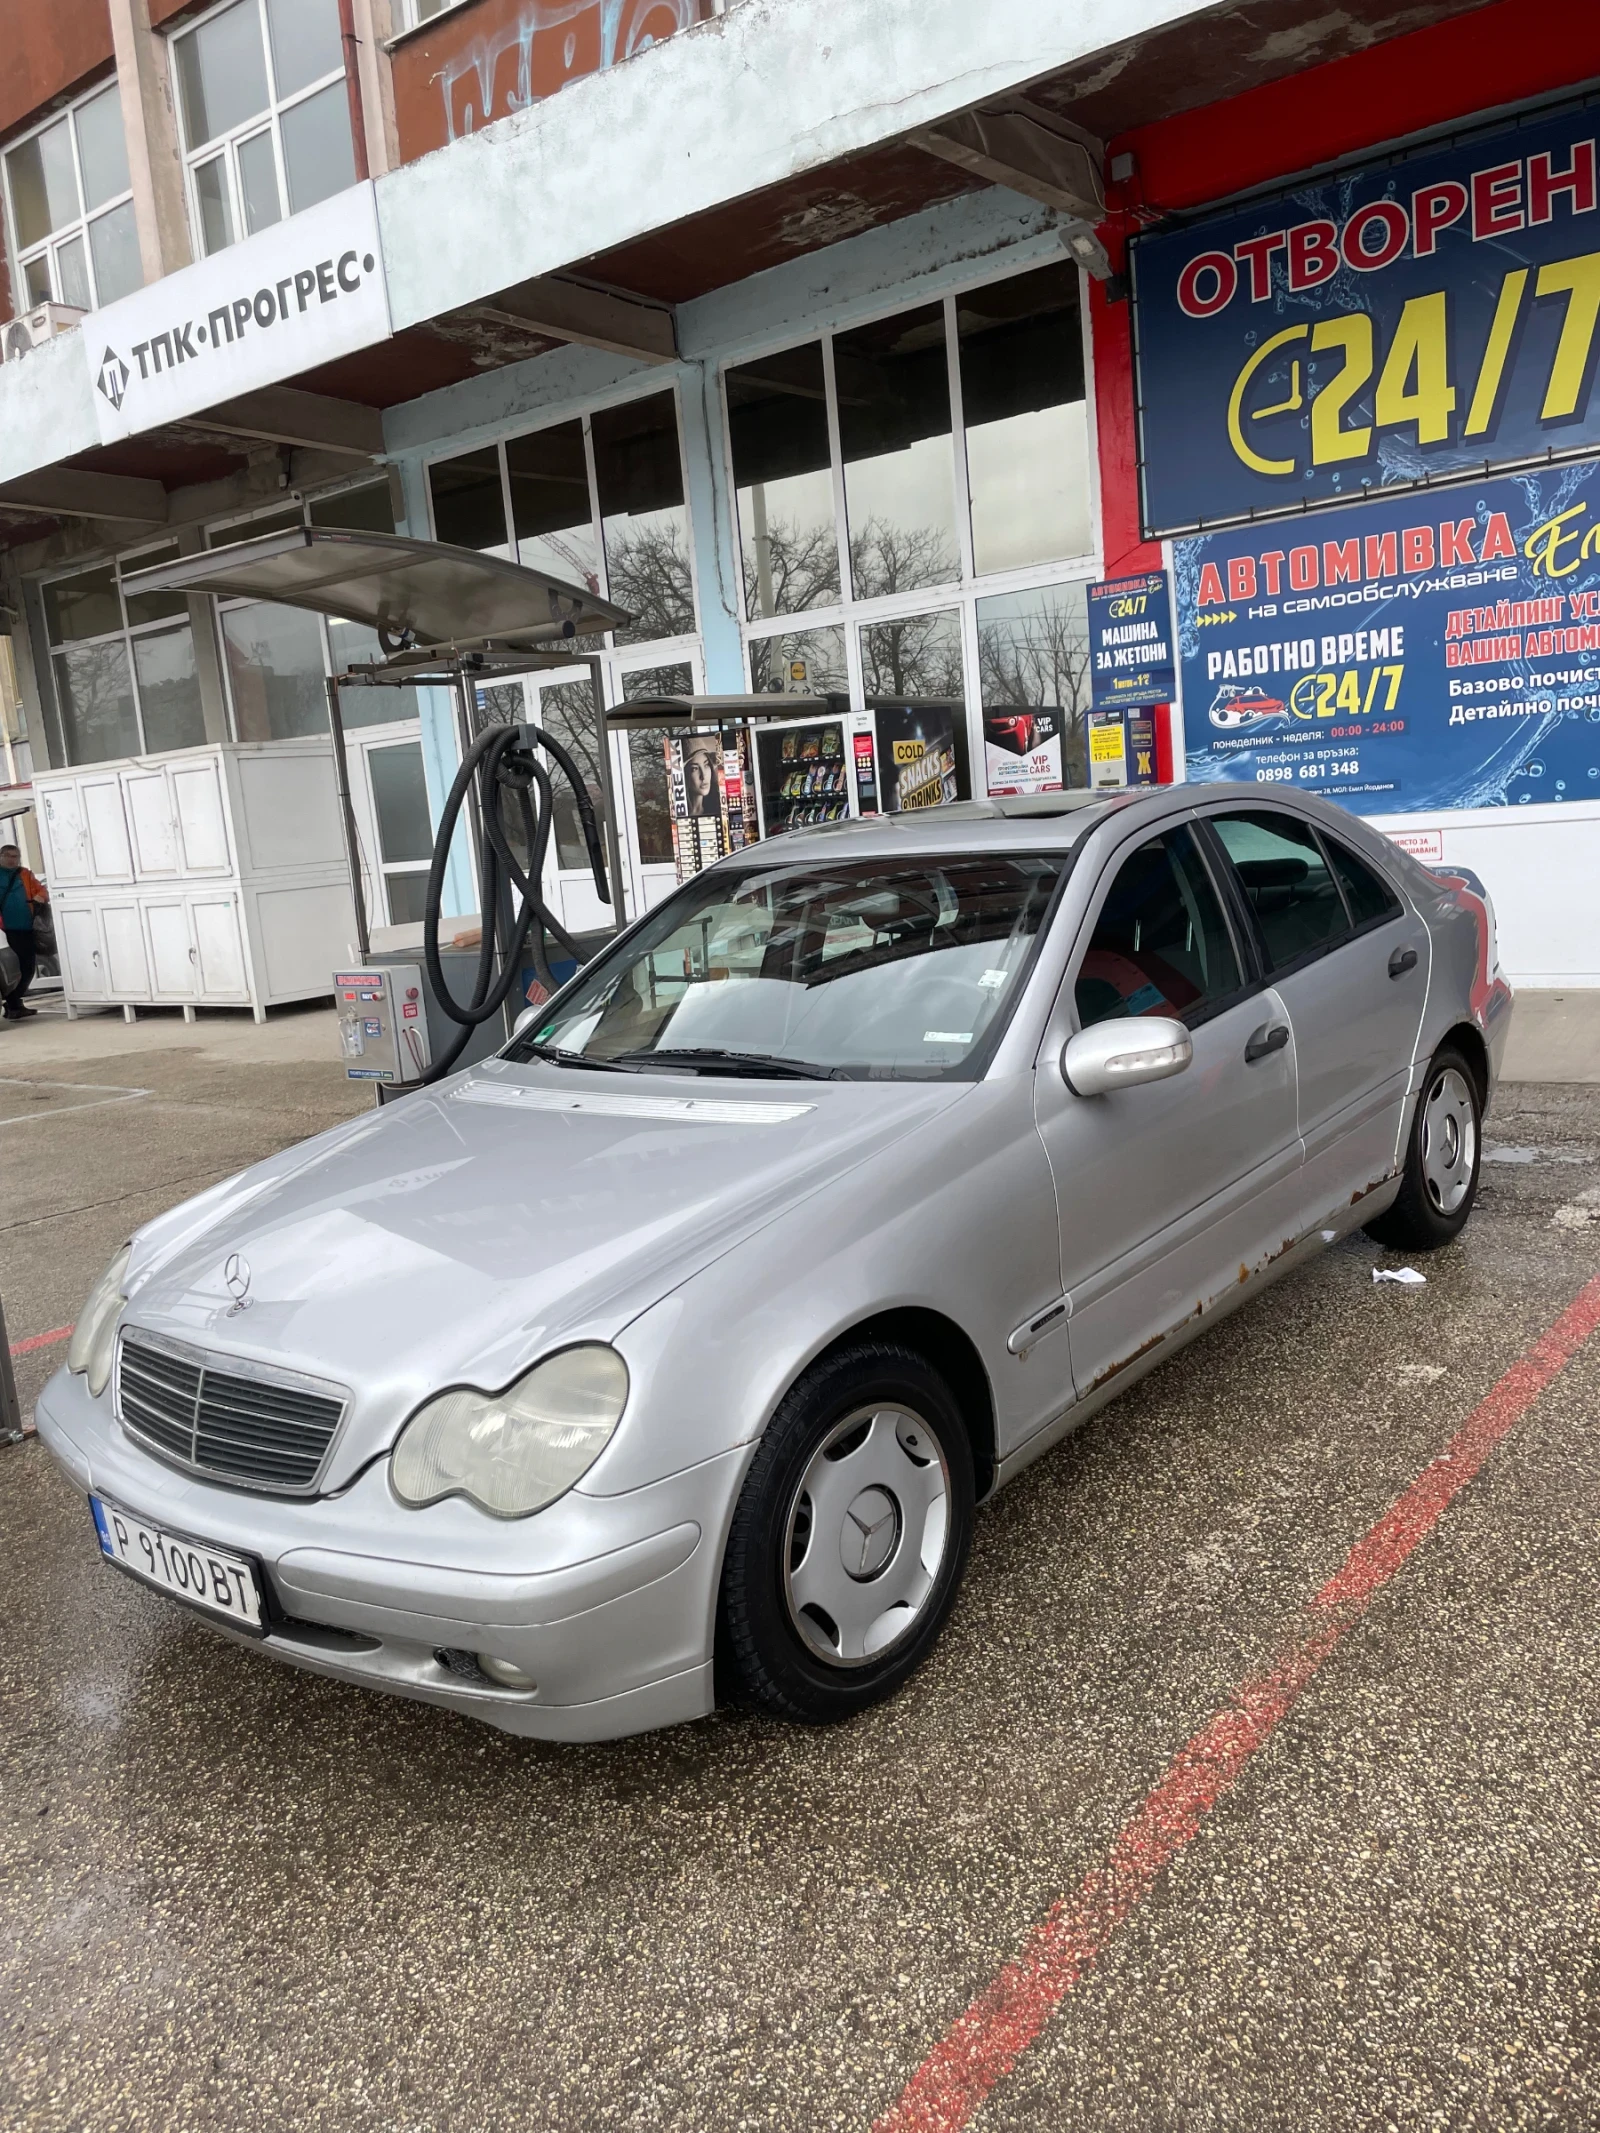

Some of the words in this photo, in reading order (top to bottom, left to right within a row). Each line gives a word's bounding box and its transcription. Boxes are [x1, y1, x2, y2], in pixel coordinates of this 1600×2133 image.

[1311, 252, 1600, 466] 24/7
[1197, 512, 1516, 606] АВТОМИВКА
[1118, 595, 1147, 617] 24/7
[1248, 603, 1277, 619] на
[1283, 567, 1517, 614] самообслужване
[1445, 596, 1565, 639] ДЕТАЙЛИНГ
[1102, 621, 1158, 646] МАШИНА
[1097, 651, 1112, 669] ЗА
[1114, 642, 1167, 667] ЖЕТОНИ
[1207, 639, 1315, 680] РАБОТНО
[1321, 625, 1404, 666] ВРЕМЕ
[1446, 635, 1521, 667] ВАШИЯ
[1316, 664, 1404, 718] 24/7
[1449, 676, 1524, 696] Базово
[1037, 717, 1051, 726] VIP
[1449, 699, 1551, 726] Детайлно
[1036, 724, 1053, 733] CARS
[1213, 734, 1273, 750] понеделник
[1282, 730, 1324, 743] неделя:
[1331, 726, 1361, 737] 00:00
[1373, 720, 1405, 733] 24:00
[897, 745, 924, 759] COLD
[1032, 755, 1048, 765] VIP
[1256, 752, 1300, 764] телефон
[1303, 751, 1314, 759] за
[1317, 746, 1359, 760] връзка:
[670, 739, 688, 817] BREAK
[900, 748, 941, 798] SNACKS
[1029, 764, 1051, 774] CARS
[1256, 767, 1292, 782] 0898
[1299, 764, 1325, 778] 681
[1330, 760, 1359, 775] 348
[910, 778, 941, 808] DRINKS
